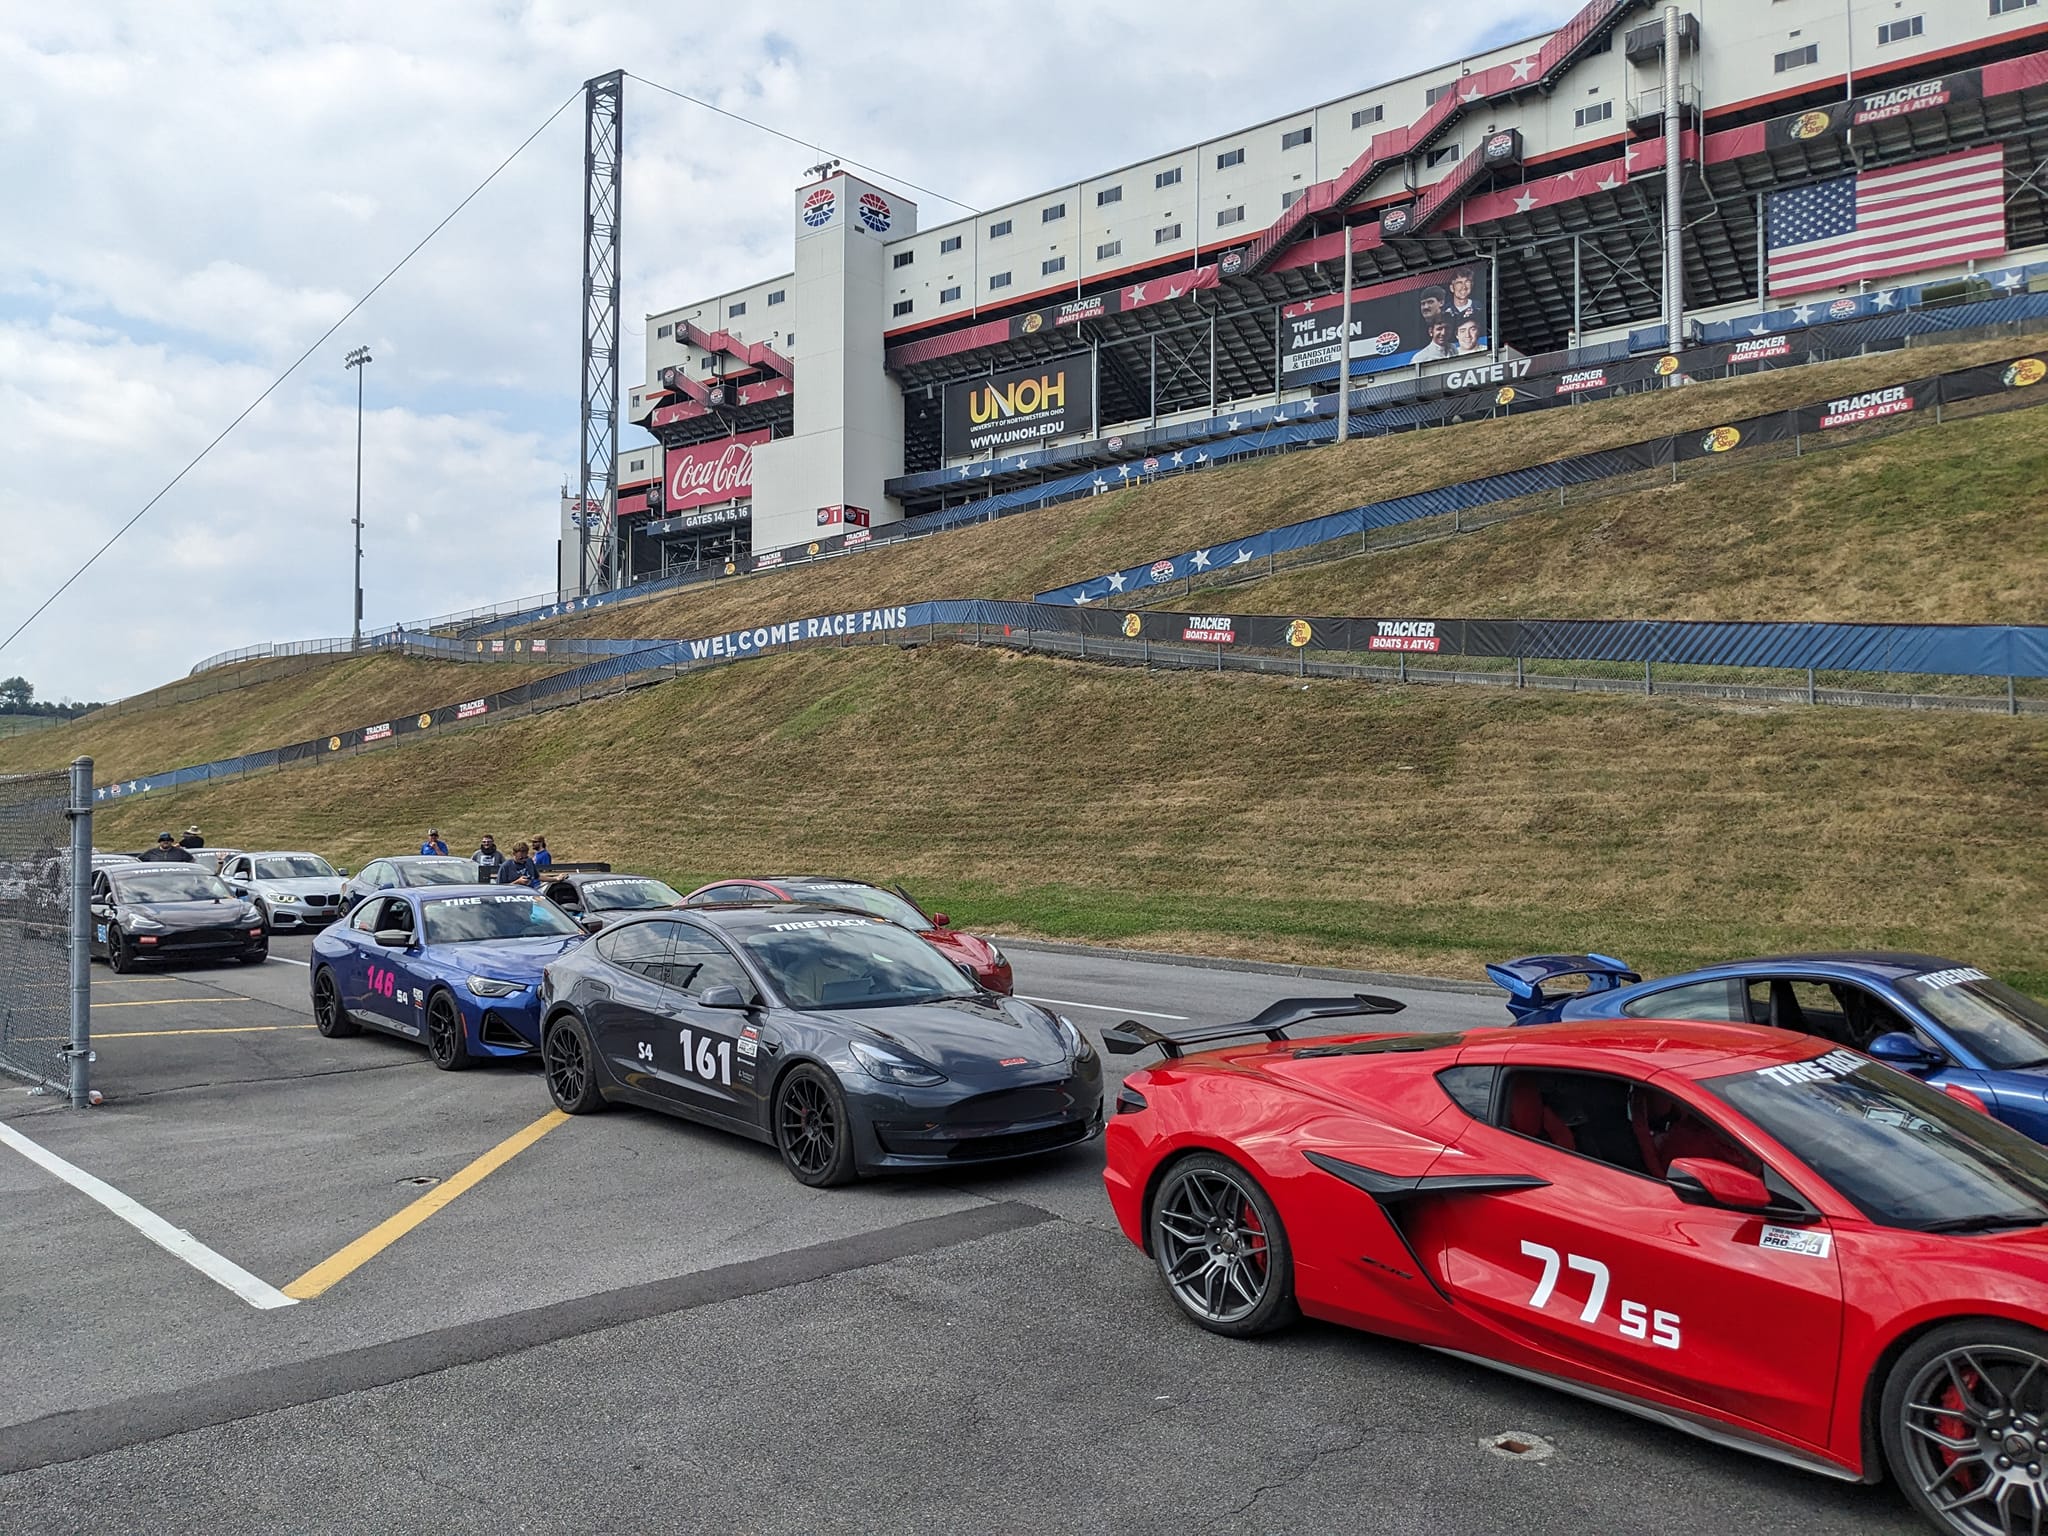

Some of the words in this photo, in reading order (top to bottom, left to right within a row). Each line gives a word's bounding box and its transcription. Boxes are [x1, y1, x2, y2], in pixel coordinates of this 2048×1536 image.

[1864, 80, 1942, 110] TRACKER
[1859, 106, 1900, 122] BOATS
[1912, 96, 1944, 110] ATVs
[1061, 298, 1102, 316] TRACKER
[1292, 318, 1316, 332] THE
[1736, 336, 1786, 353] TRACKER
[1292, 346, 1342, 362] GRANDSTAND
[1301, 354, 1332, 368] TERRACE
[1732, 351, 1758, 361] BOATS
[1446, 364, 1504, 390] GATE
[1509, 359, 1532, 378] 17
[1562, 370, 1602, 384] TRACKER
[970, 372, 1064, 424] UNOH
[1828, 386, 1904, 416] TRACKER
[970, 421, 998, 432] UNIVERSITY
[1006, 412, 1050, 425] NORTHWESTERN
[1050, 408, 1064, 416] OHIO
[1824, 410, 1866, 426] BOATS
[1876, 402, 1908, 416] ATVs
[971, 421, 1064, 448] WWW.UNOH.EDU
[686, 514, 712, 526] GATES
[715, 511, 725, 522] 14,
[727, 510, 737, 520] 15,
[739, 508, 748, 518] 16
[690, 622, 800, 658] WELCOME
[807, 614, 855, 638] RACE
[862, 607, 907, 631] FANS
[1190, 617, 1231, 630] TRACKER
[1377, 622, 1435, 636] TRACKER
[1186, 630, 1208, 640] BOATS
[1213, 632, 1231, 642] ATVs
[1373, 638, 1402, 648] BOATS
[1403, 641, 1408, 649] &
[1410, 640, 1435, 650] ATVs
[460, 699, 484, 712] TRACKER
[366, 722, 390, 734] TRACKER
[441, 897, 482, 906] TIRE
[768, 920, 819, 932] TIRE
[820, 919, 873, 928] RACK
[368, 965, 394, 998] 146
[396, 990, 408, 1005] S4
[1916, 970, 1962, 990] TIRE
[1946, 968, 1992, 982] RAC
[638, 1042, 653, 1061] S4
[680, 1028, 731, 1086] 161
[1756, 1062, 1836, 1086] TIRE
[1816, 1050, 1870, 1076] RAC
[1763, 1236, 1788, 1247] PRO
[1520, 1240, 1610, 1324] 77
[1619, 1300, 1680, 1350] SS
